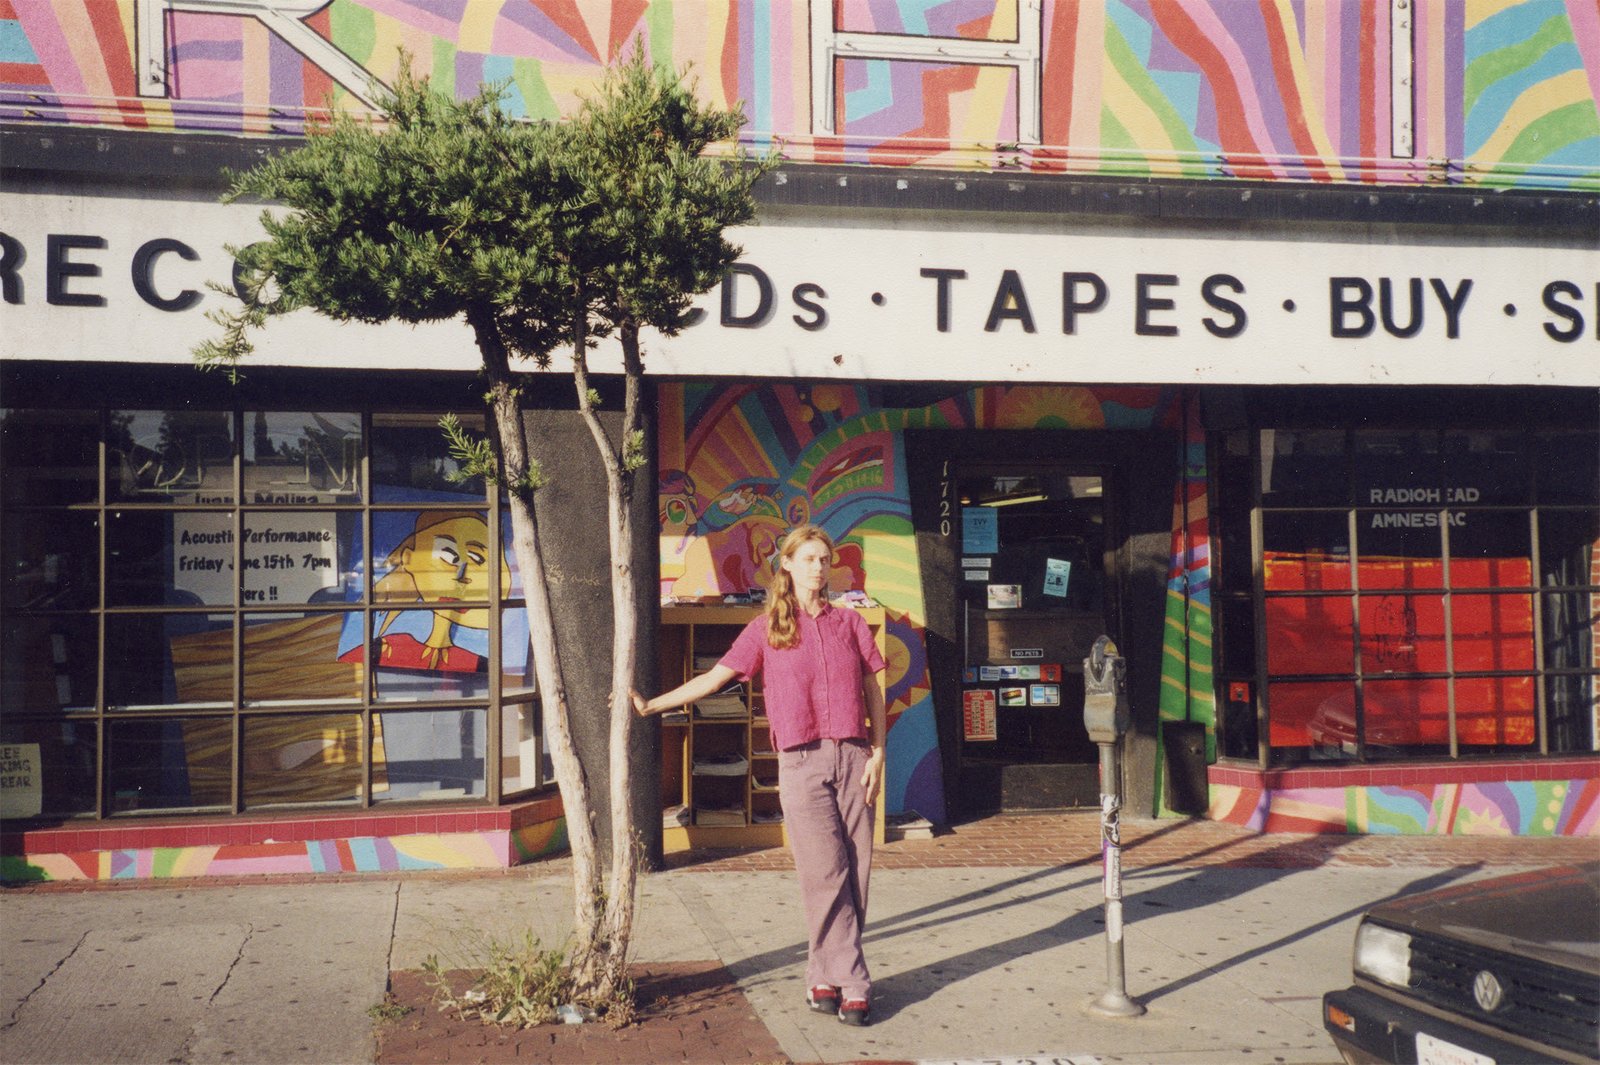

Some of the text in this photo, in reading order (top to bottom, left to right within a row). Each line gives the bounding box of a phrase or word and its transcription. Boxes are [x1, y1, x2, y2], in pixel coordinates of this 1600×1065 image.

[678, 263, 829, 331] Ds
[919, 268, 1249, 339] TAPES
[1329, 276, 1473, 340] BUY
[1542, 280, 1600, 343] S
[940, 460, 951, 536] 1720
[180, 529, 234, 546] Acousti
[179, 553, 224, 573] Friday
[263, 554, 295, 570] 15th
[302, 553, 331, 571] 7pm
[242, 586, 265, 601] ere
